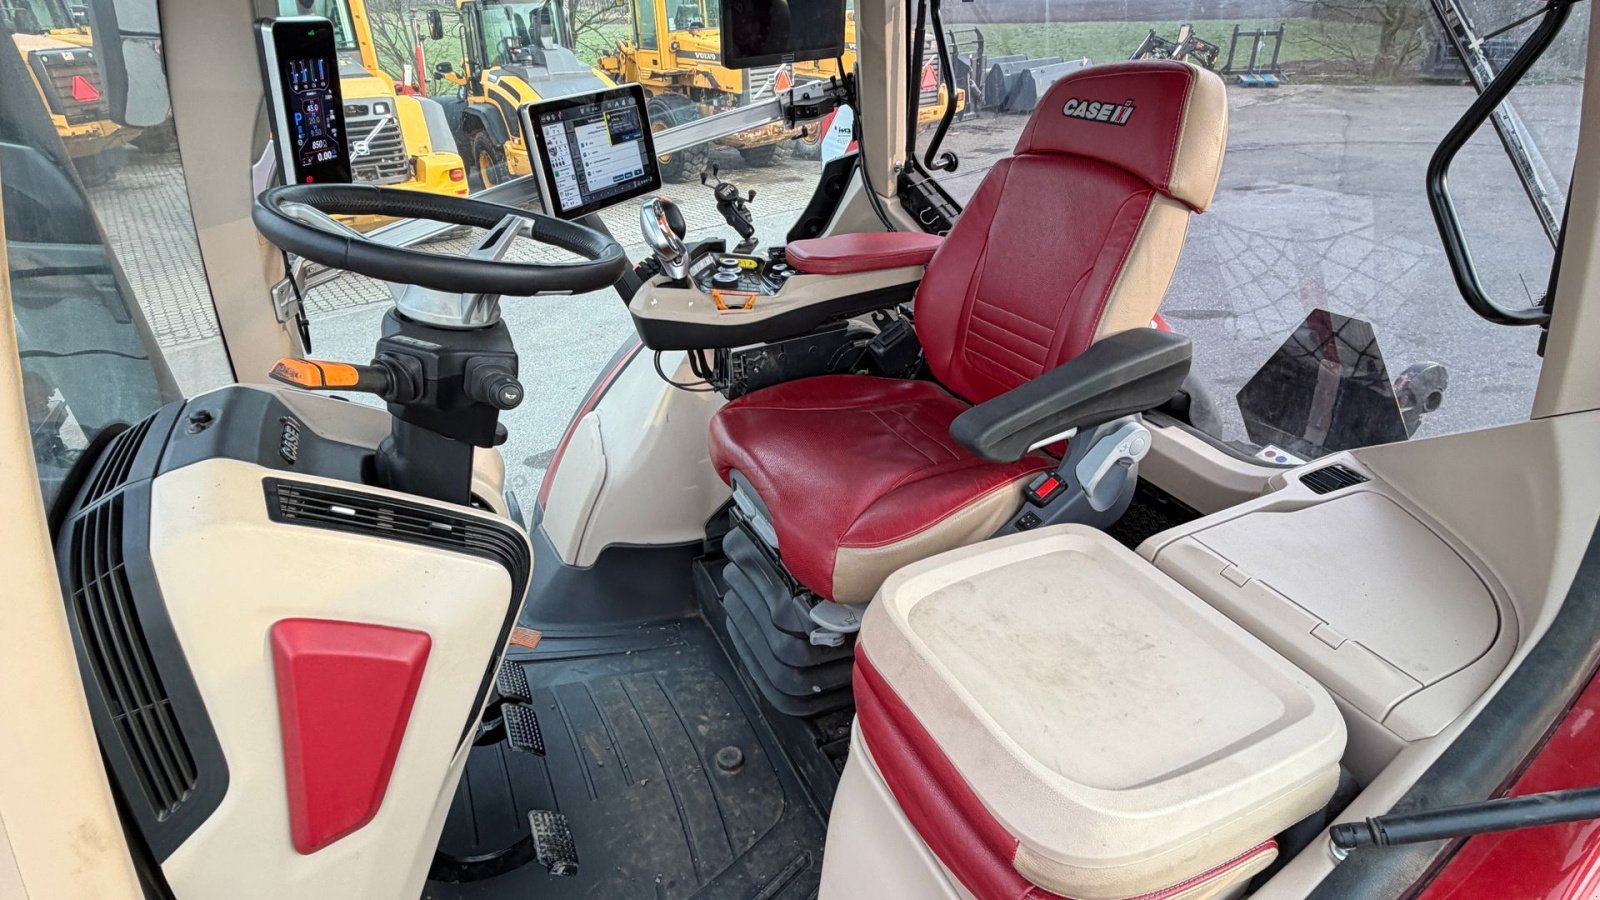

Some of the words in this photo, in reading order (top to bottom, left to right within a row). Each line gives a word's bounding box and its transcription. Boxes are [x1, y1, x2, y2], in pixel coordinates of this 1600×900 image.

[694, 52, 716, 60] VOLVO
[1063, 98, 1114, 121] CASE
[295, 112, 302, 125] P
[317, 151, 332, 161] 0.00
[282, 425, 300, 461] CASE
